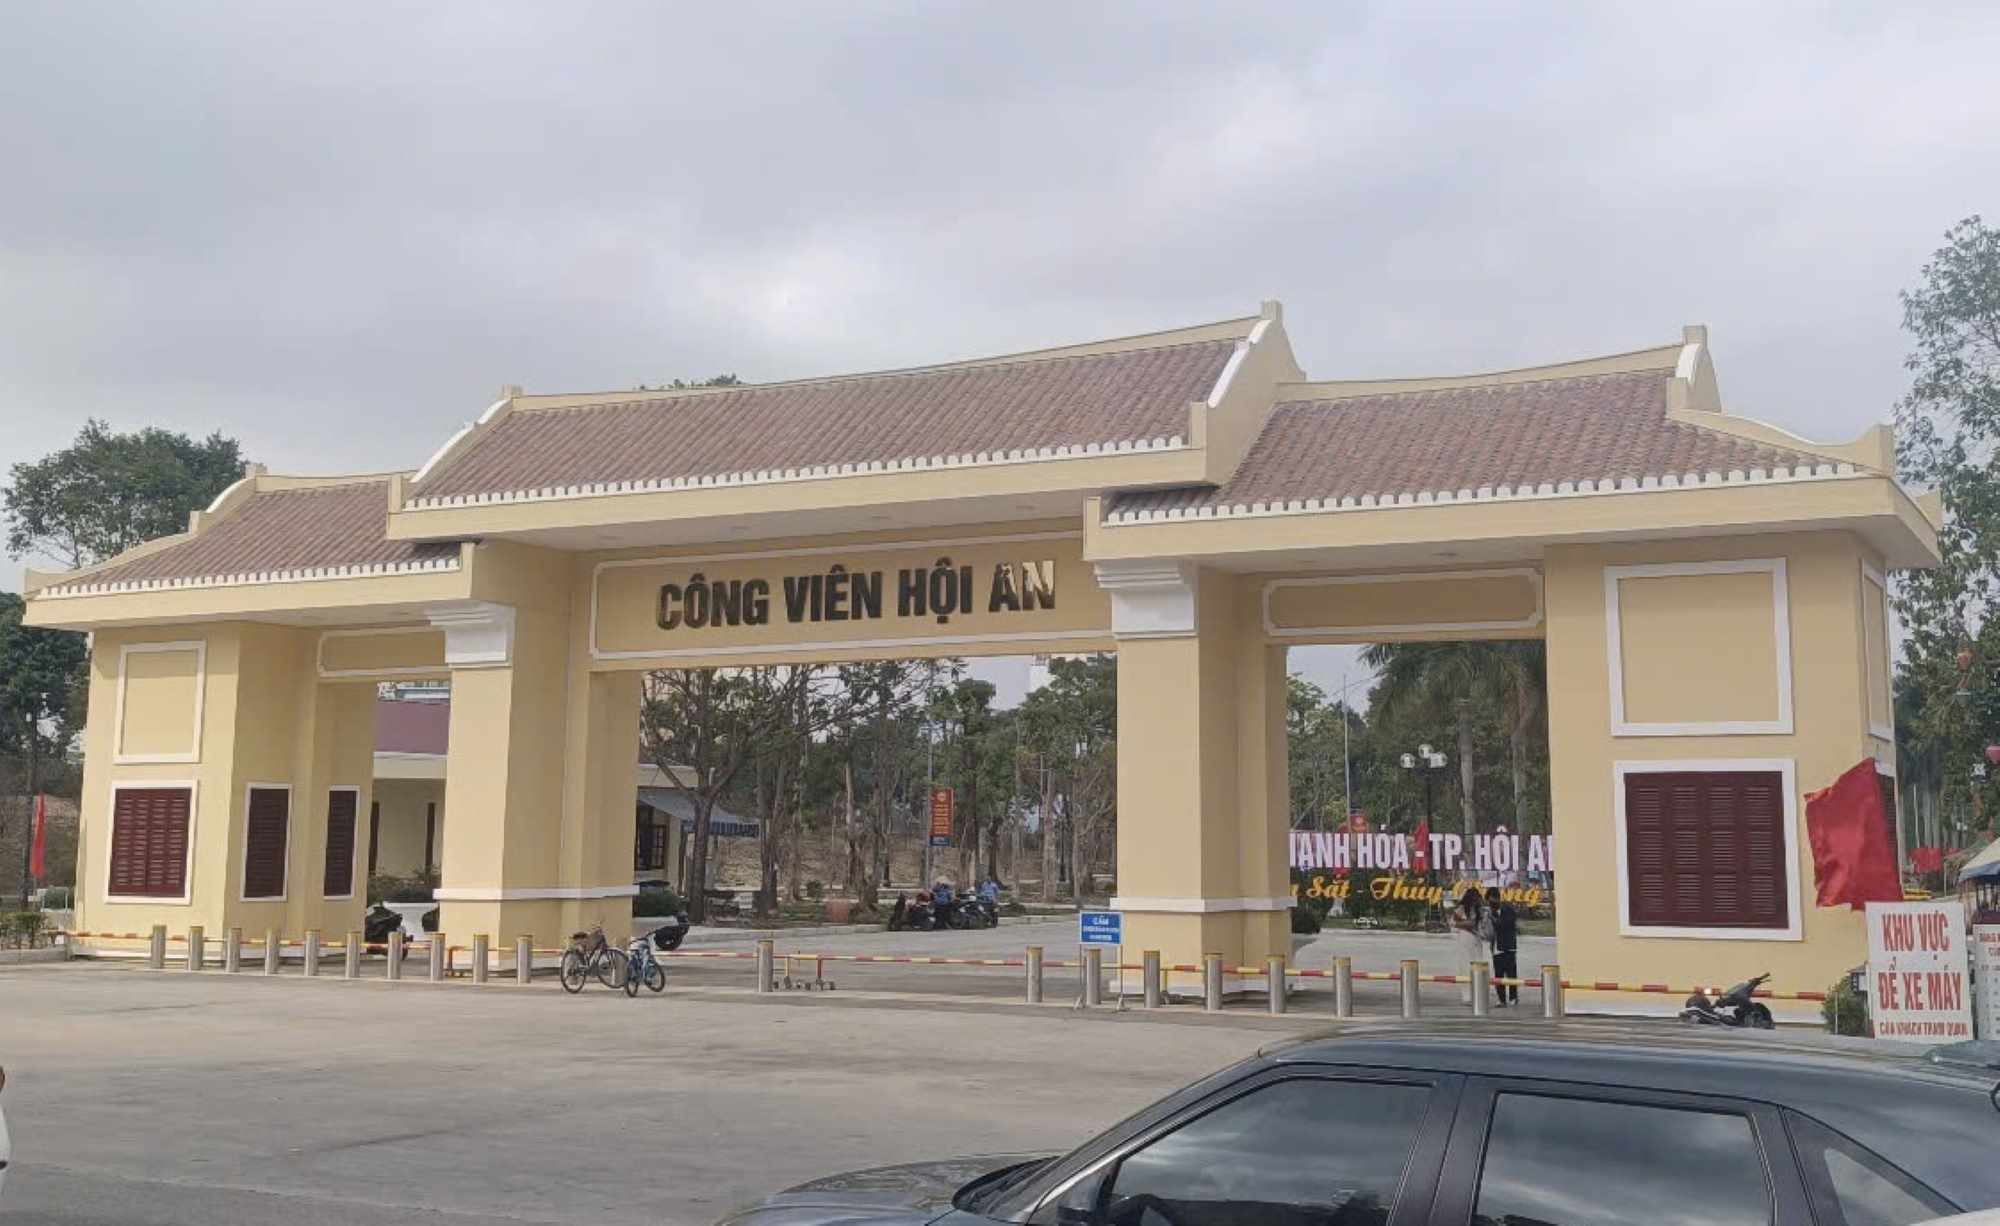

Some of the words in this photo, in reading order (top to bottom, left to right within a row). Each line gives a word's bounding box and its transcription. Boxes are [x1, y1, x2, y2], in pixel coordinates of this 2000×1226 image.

[656, 573, 769, 631] CÔNG
[783, 564, 883, 624] VIÊN
[898, 556, 974, 624] HỘI
[988, 560, 1056, 613] AN
[1429, 833, 1466, 870] TP.
[1882, 912, 1915, 952] KHU
[1917, 909, 1951, 961] VỰC
[1902, 972, 1924, 1011] XE
[1926, 964, 1962, 1011] MÁY
